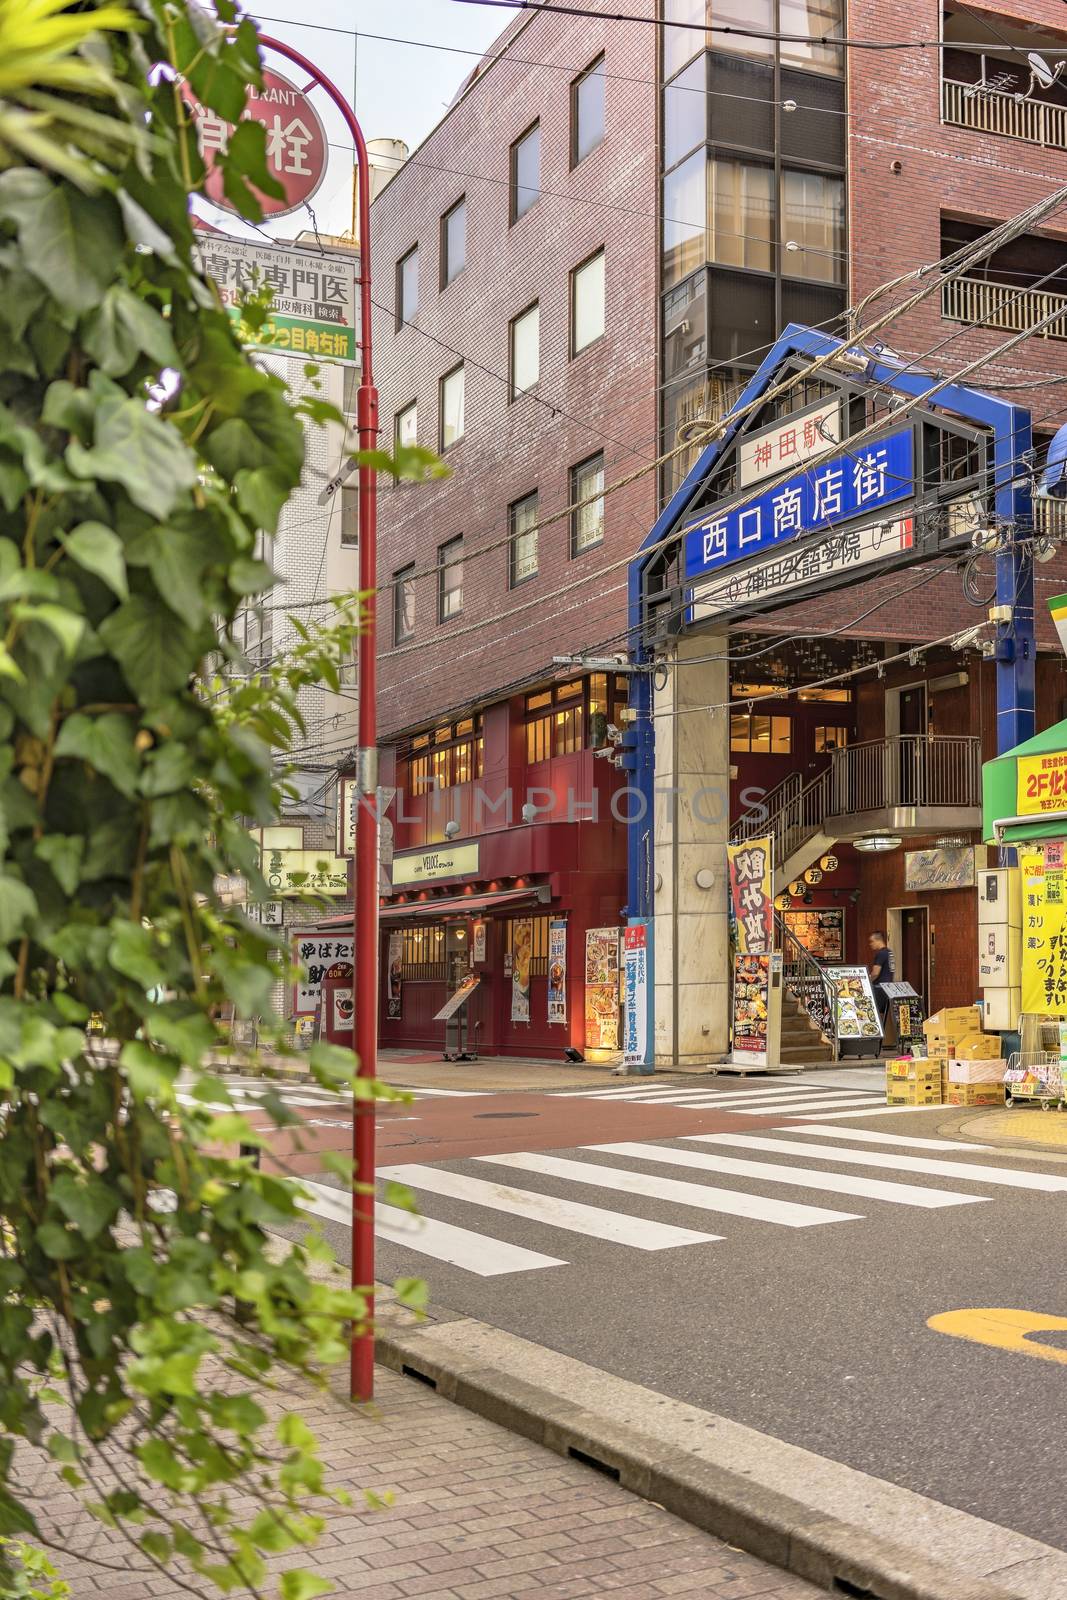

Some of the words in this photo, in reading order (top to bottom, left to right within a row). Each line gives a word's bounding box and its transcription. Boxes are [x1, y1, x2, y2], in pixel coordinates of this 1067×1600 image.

[193, 253, 349, 305] 膚科専門医
[754, 414, 825, 472] 神田駅
[701, 449, 888, 565] 西口商店街
